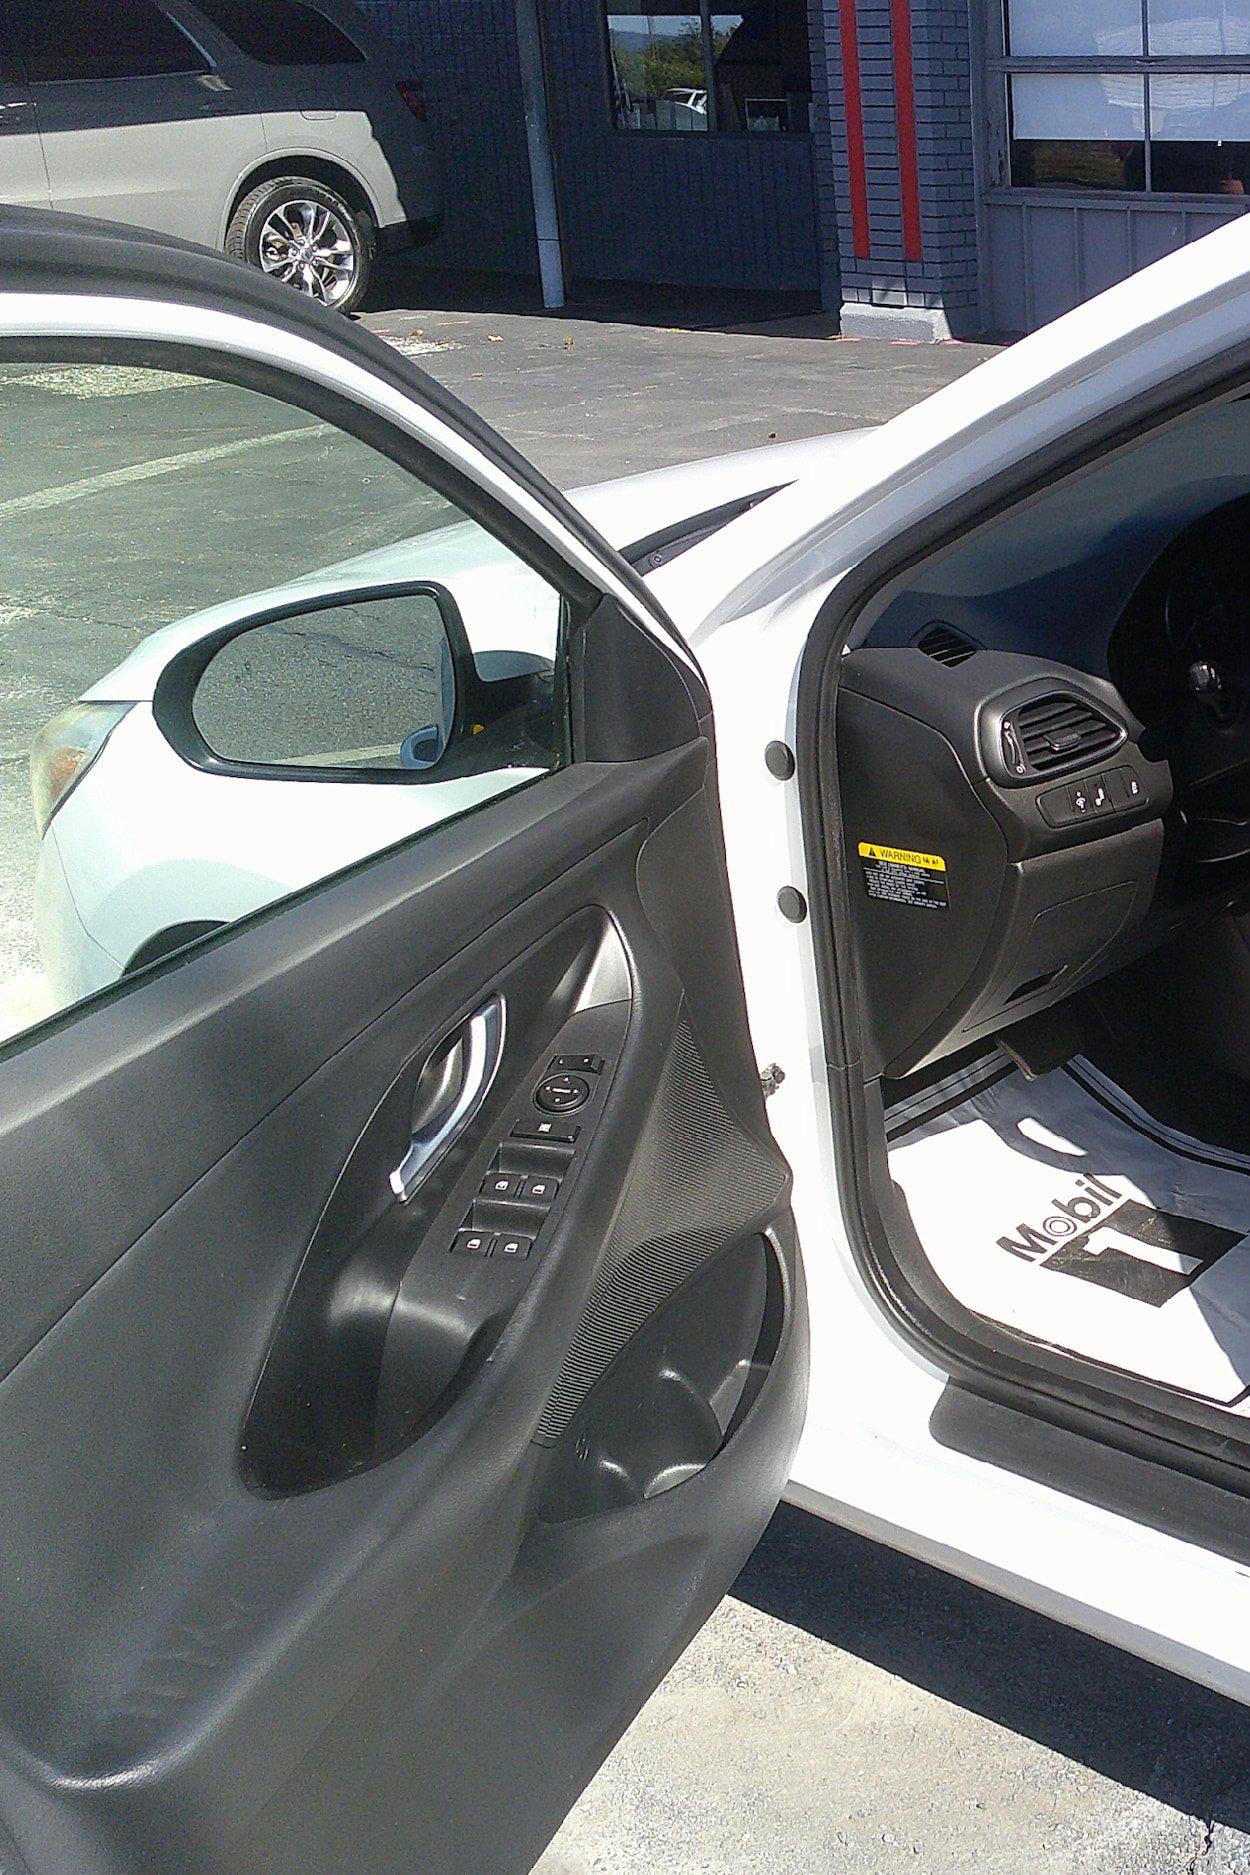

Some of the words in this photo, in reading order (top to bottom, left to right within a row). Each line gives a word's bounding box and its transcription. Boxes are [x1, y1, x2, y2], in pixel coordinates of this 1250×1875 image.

[880, 848, 922, 864] WARNING
[996, 1172, 1123, 1263] Mobil
[1083, 1226, 1204, 1275] 1
